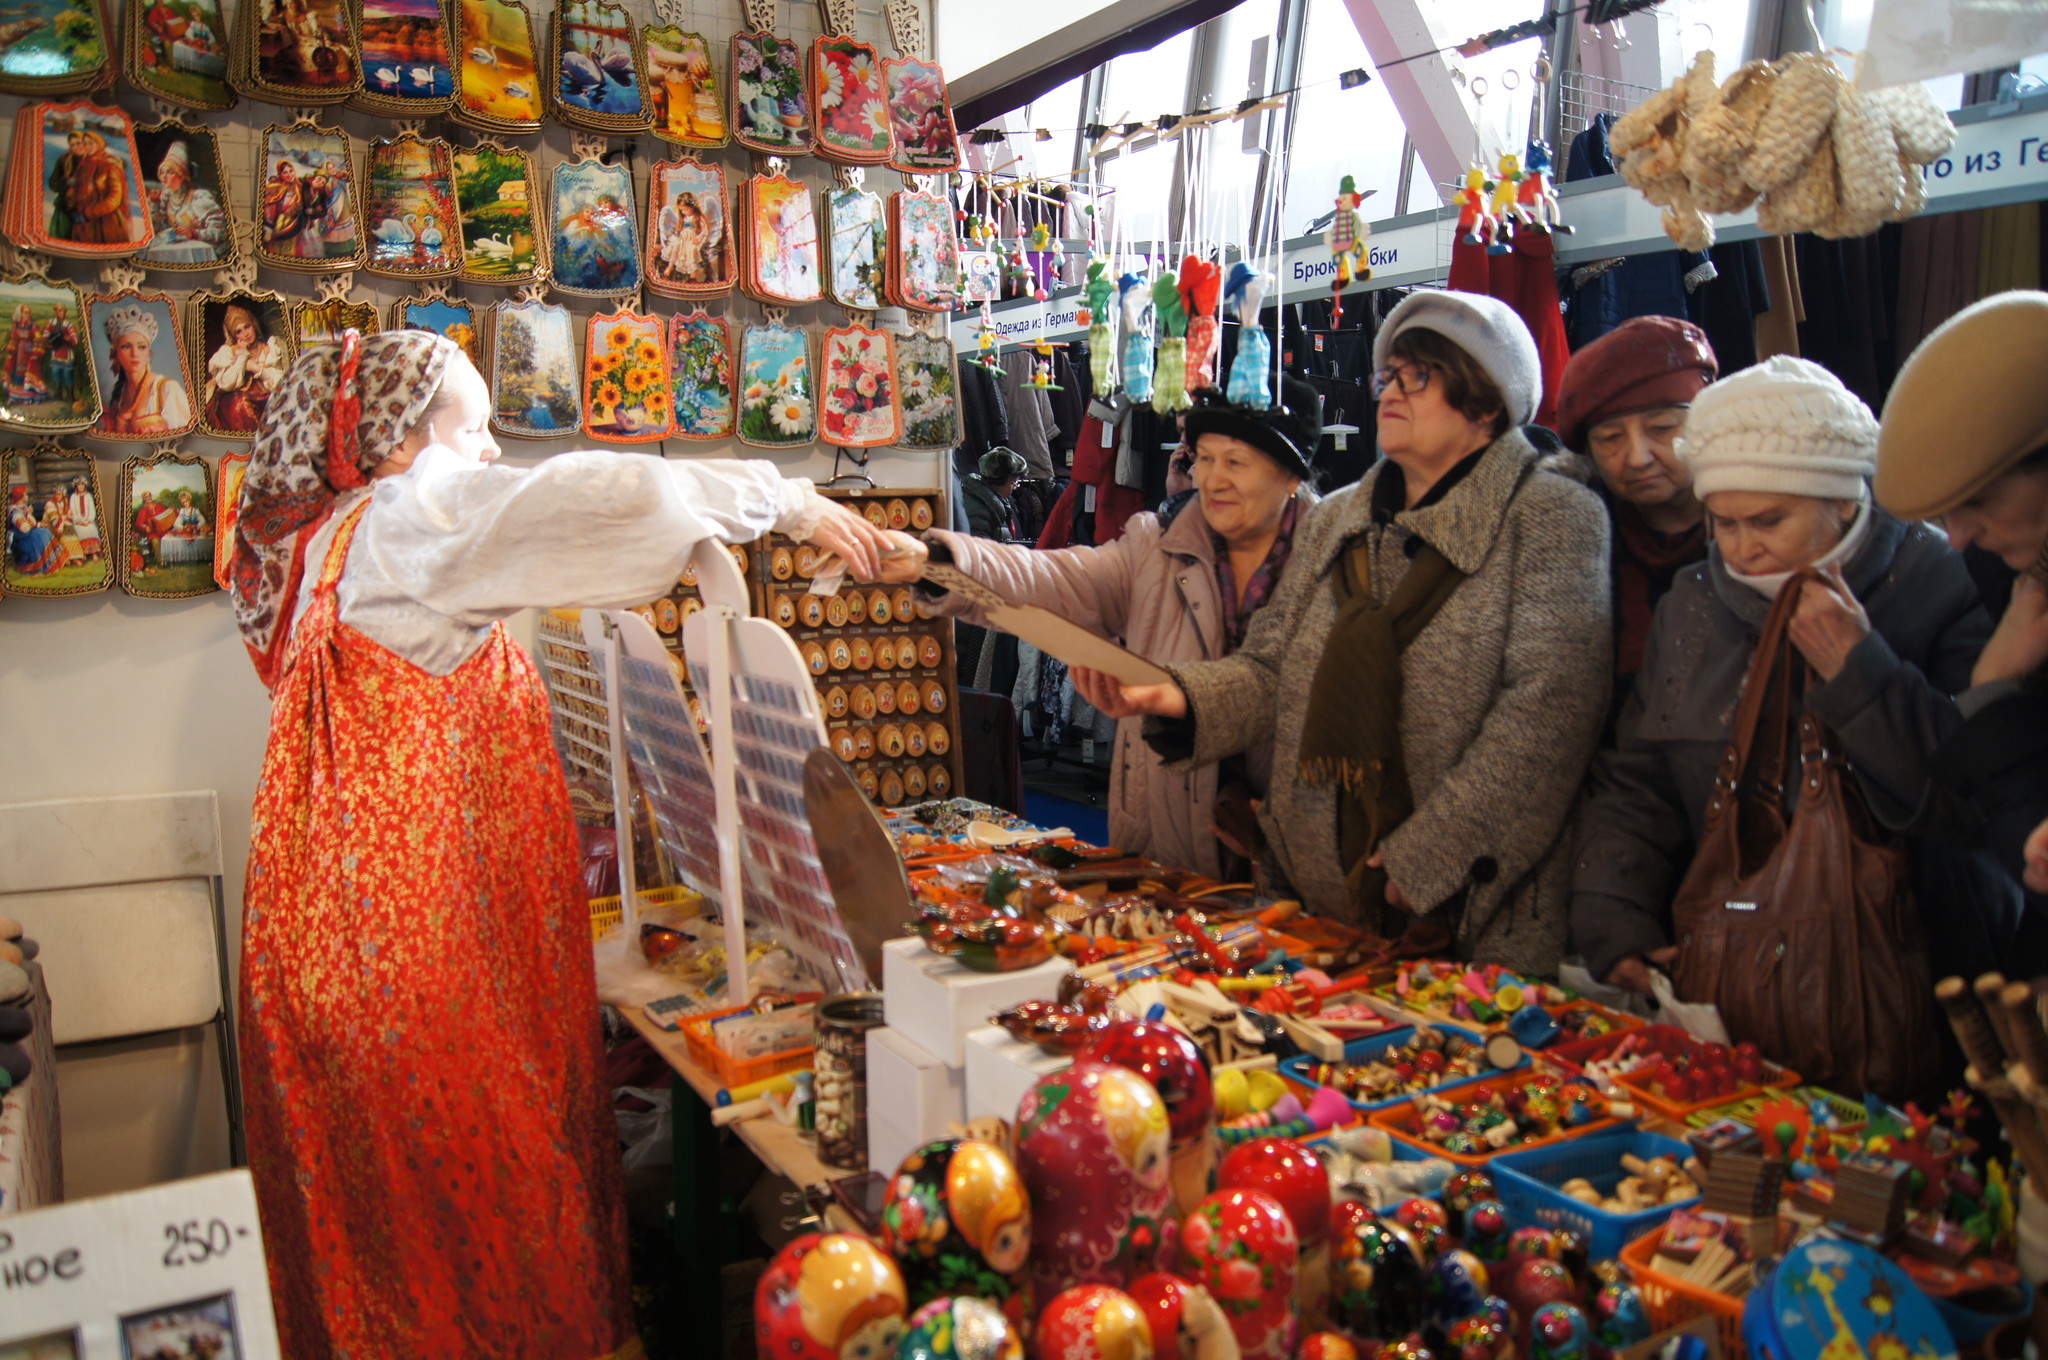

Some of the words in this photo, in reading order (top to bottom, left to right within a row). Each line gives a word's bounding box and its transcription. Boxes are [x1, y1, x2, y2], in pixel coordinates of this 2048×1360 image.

[1922, 159, 1953, 180] то
[1965, 151, 2001, 174] из
[2019, 137, 2048, 166] Ге
[1294, 261, 1336, 282] Брюк
[1369, 246, 1398, 266] бки
[995, 320, 1030, 336] Одежда
[1045, 308, 1089, 329] Герма
